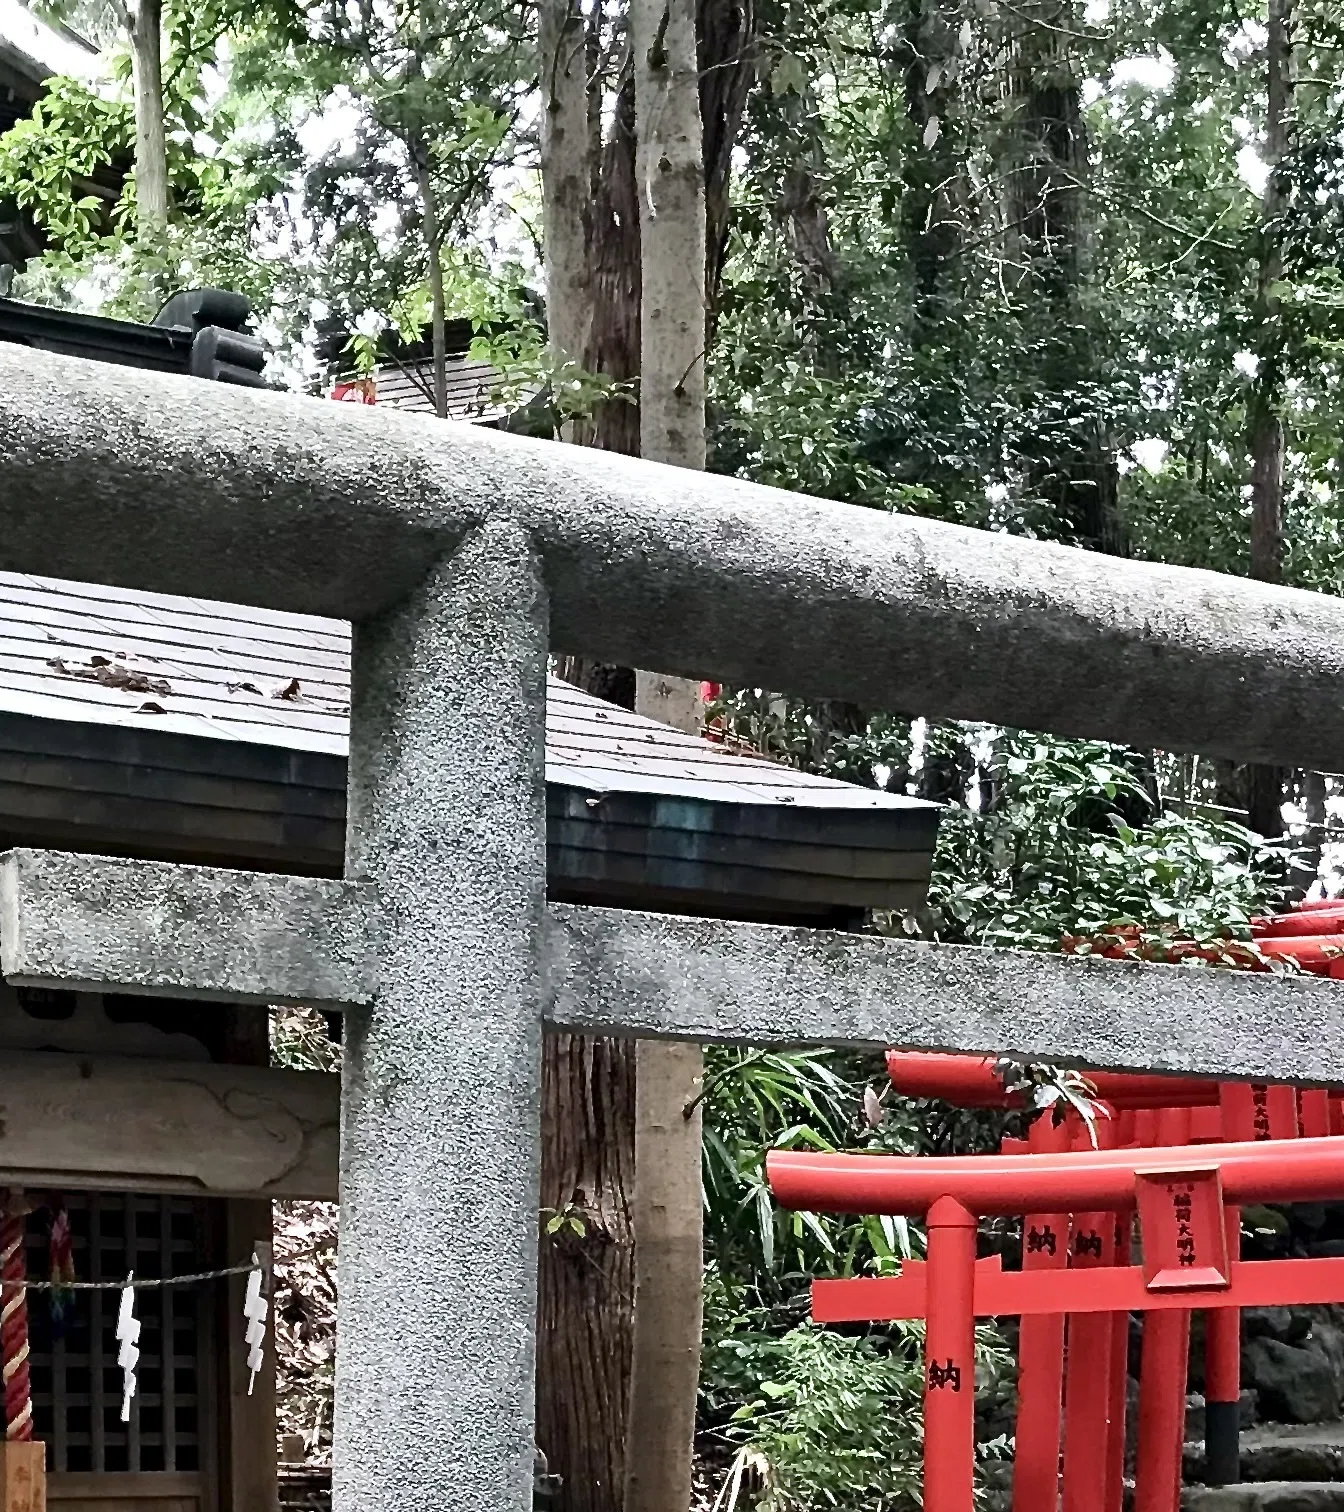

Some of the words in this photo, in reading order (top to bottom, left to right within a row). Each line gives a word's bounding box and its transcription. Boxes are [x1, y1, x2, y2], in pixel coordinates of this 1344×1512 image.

[1027, 1225, 1057, 1257] 納
[1074, 1229, 1103, 1260] 納
[1173, 1192, 1197, 1268] 稲荷大明神
[928, 1357, 962, 1394] 納
